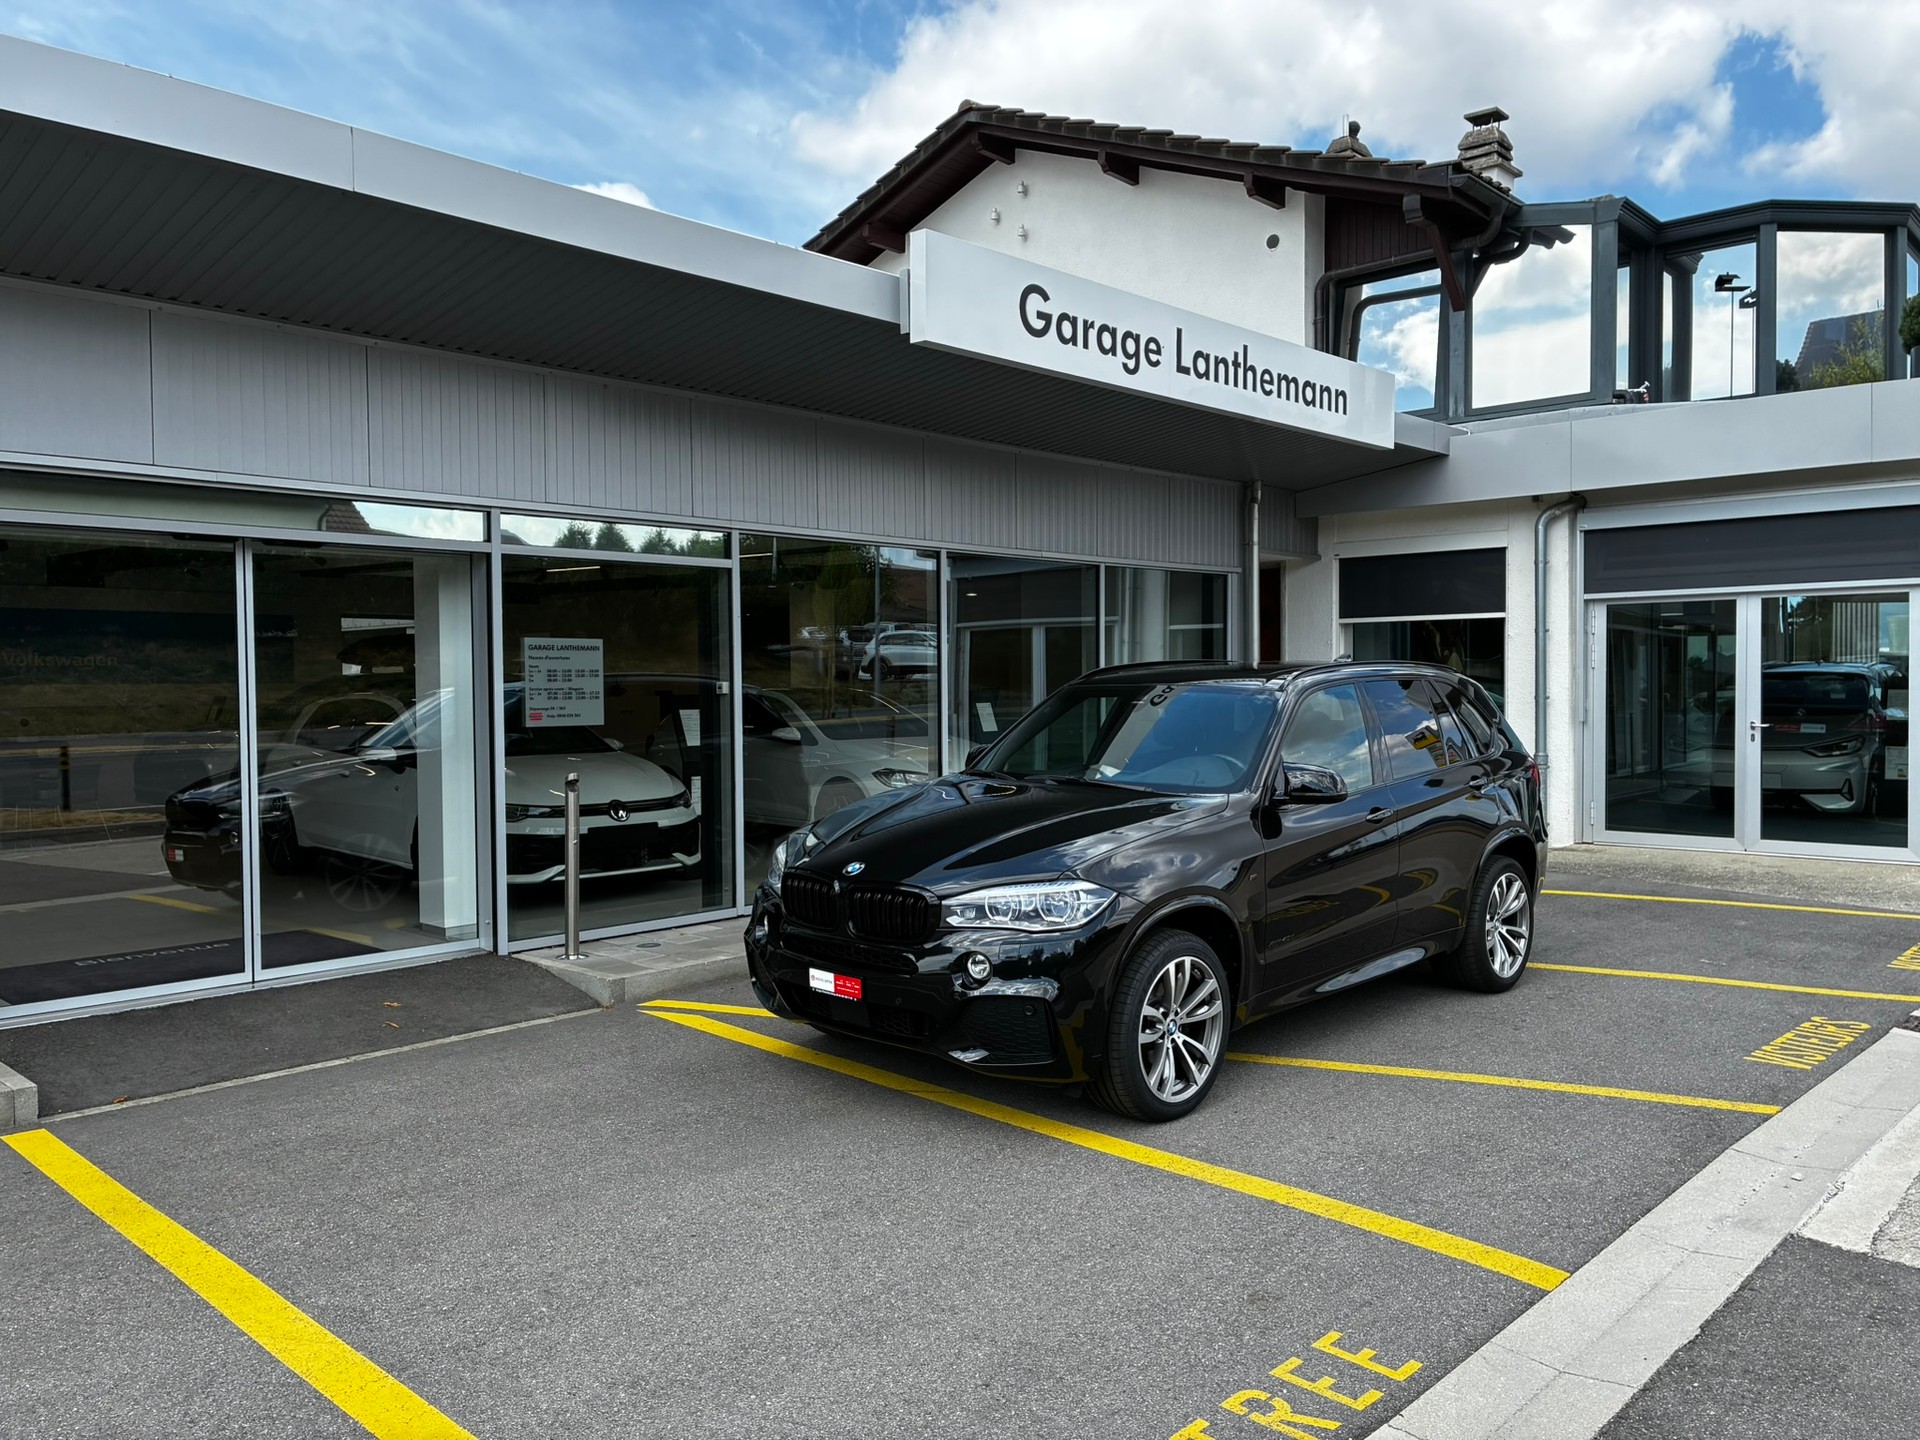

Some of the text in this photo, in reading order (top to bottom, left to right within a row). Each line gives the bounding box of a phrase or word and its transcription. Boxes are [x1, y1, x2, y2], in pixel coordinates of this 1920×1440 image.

[1019, 283, 1348, 416] Garage Lanthemann
[1, 651, 118, 669] Volkswagen
[556, 644, 600, 652] LANTHEMANN
[1743, 1016, 1872, 1070] VISITEURS
